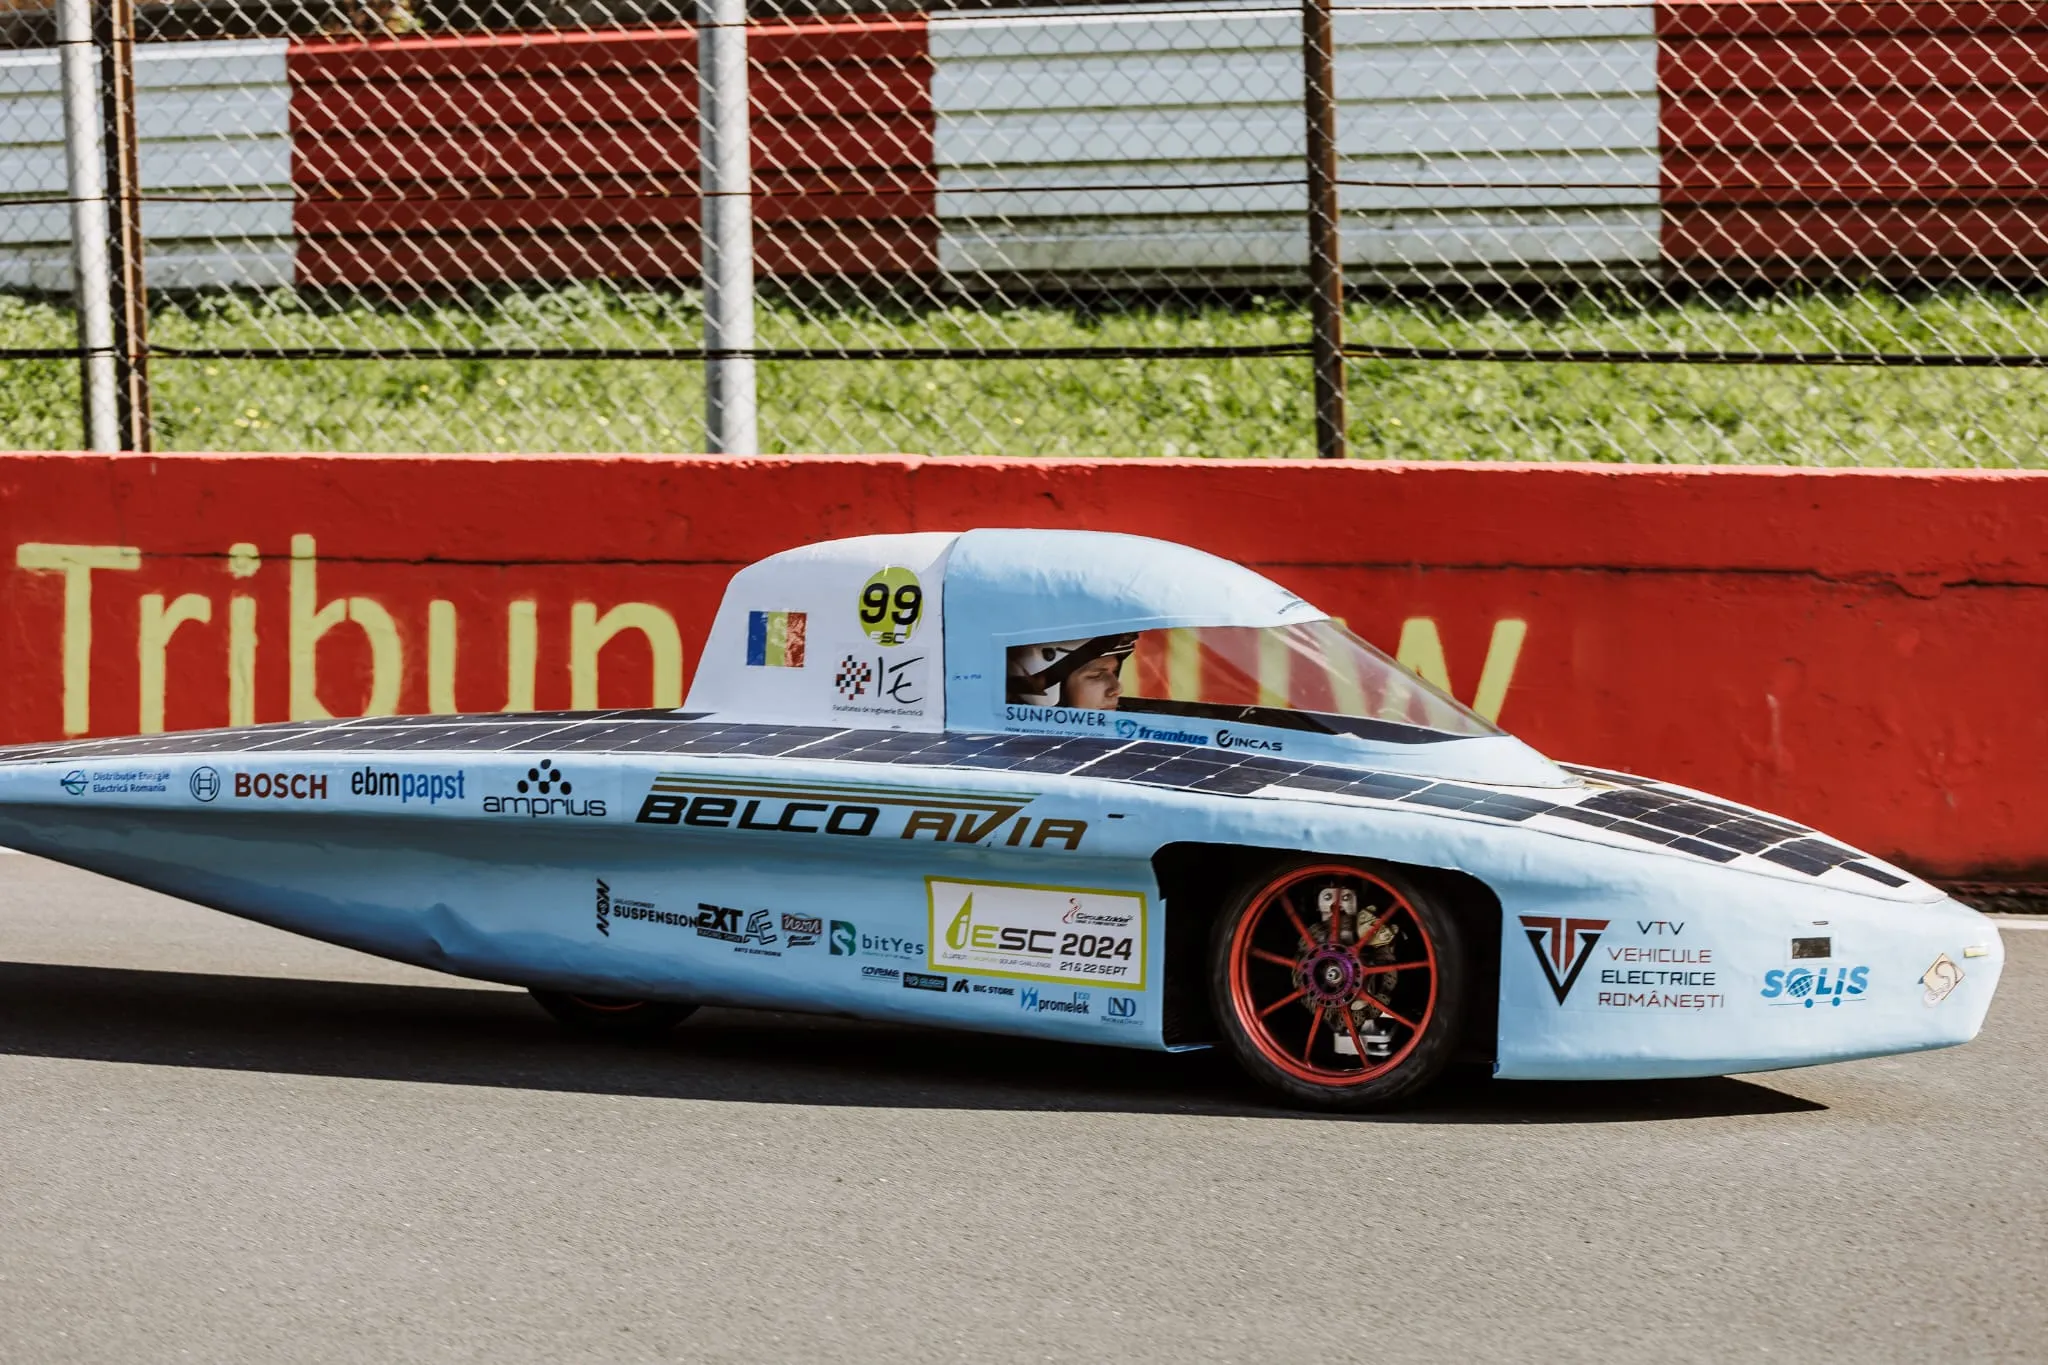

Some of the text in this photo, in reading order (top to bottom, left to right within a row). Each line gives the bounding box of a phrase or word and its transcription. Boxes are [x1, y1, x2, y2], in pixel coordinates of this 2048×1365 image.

[860, 582, 923, 625] 99
[1005, 706, 1106, 727] SUNPOWER
[1234, 737, 1283, 752] INCAS
[235, 773, 328, 799] BOSCH
[483, 796, 607, 818] amprius
[900, 807, 1089, 851] AVIA
[613, 905, 699, 928] SUSPENSION
[697, 903, 744, 933] EXT
[1636, 920, 1685, 936] VTV
[862, 934, 925, 955] bitYes
[1060, 933, 1133, 960] 2024
[1607, 946, 1712, 963] VEHICULE
[1098, 964, 1128, 976] SEPT
[1601, 969, 1716, 986] ELECTRICE
[988, 986, 1015, 996] STORE
[1761, 965, 1870, 999] SOLIS
[1038, 991, 1090, 1014] promelek
